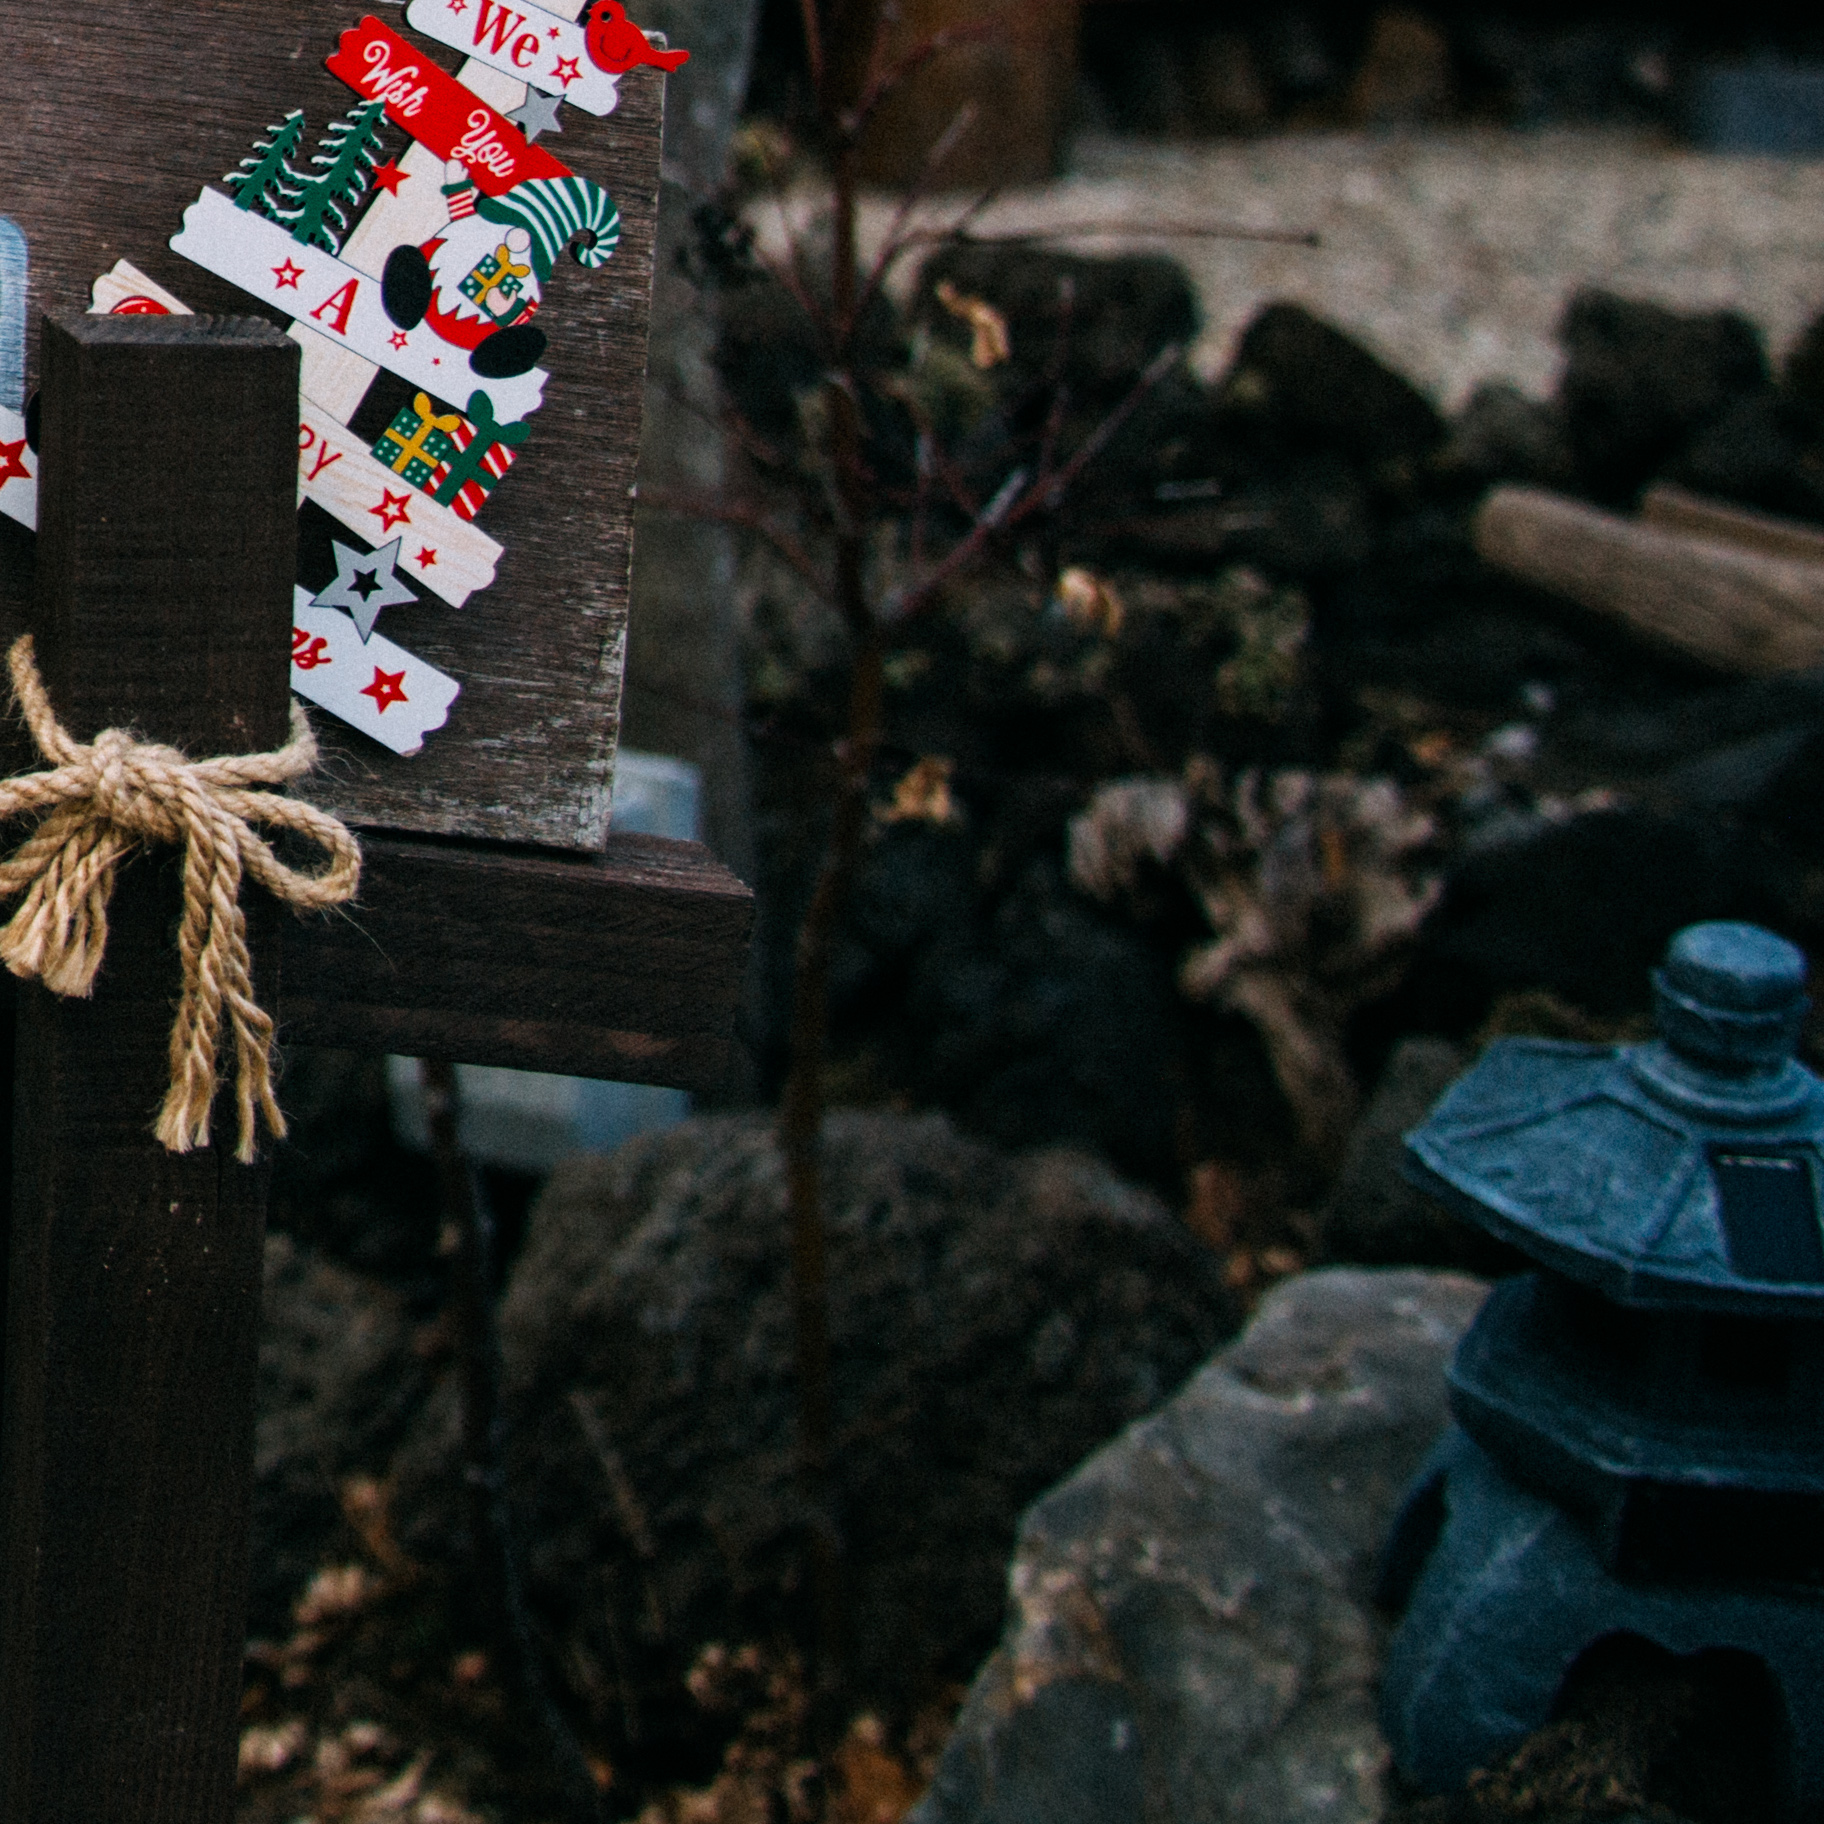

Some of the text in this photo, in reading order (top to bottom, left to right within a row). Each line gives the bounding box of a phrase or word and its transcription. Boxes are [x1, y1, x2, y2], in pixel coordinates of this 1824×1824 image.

[362, 40, 516, 178] Wish You
[309, 277, 360, 336] A
